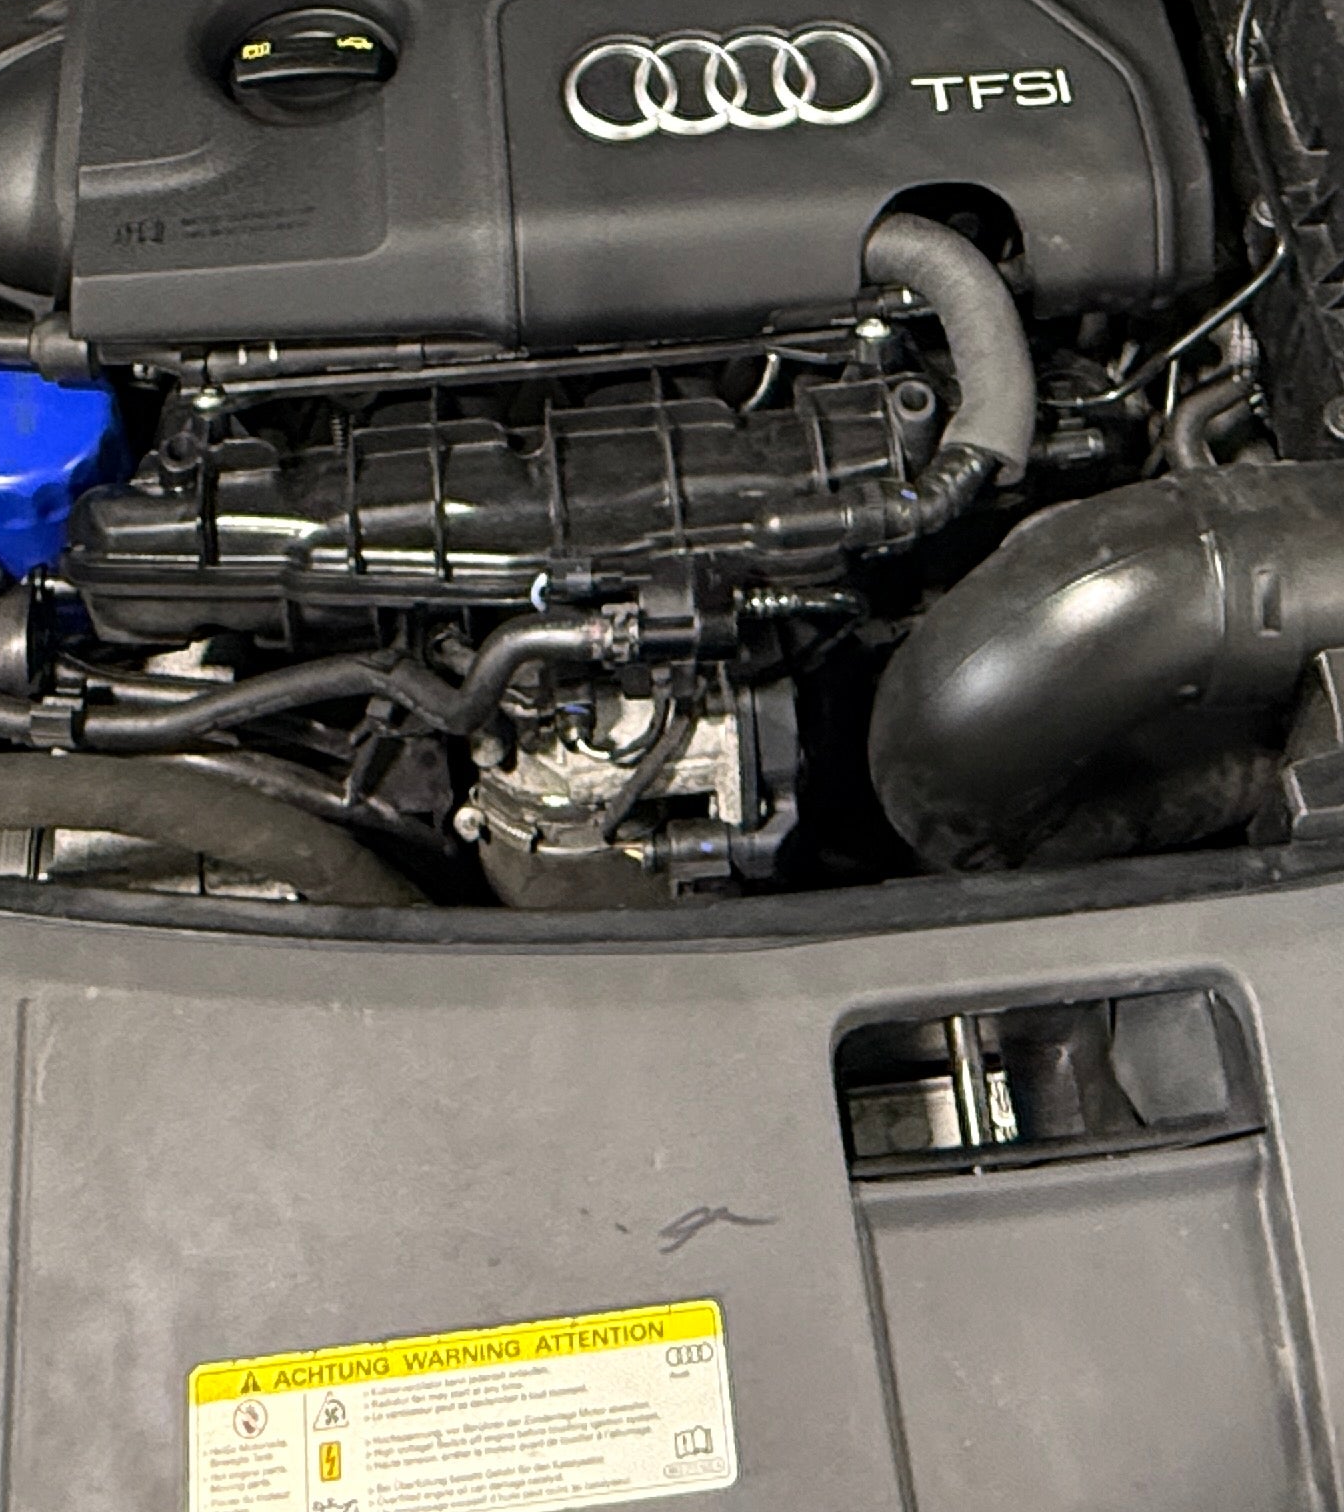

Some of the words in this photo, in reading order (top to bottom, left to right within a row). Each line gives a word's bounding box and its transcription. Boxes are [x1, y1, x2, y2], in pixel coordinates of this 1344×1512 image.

[910, 68, 1072, 112] TFSI
[273, 1356, 391, 1391] ACHTUNG
[403, 1339, 521, 1371] WARNING
[535, 1320, 665, 1355] ATTENTION
